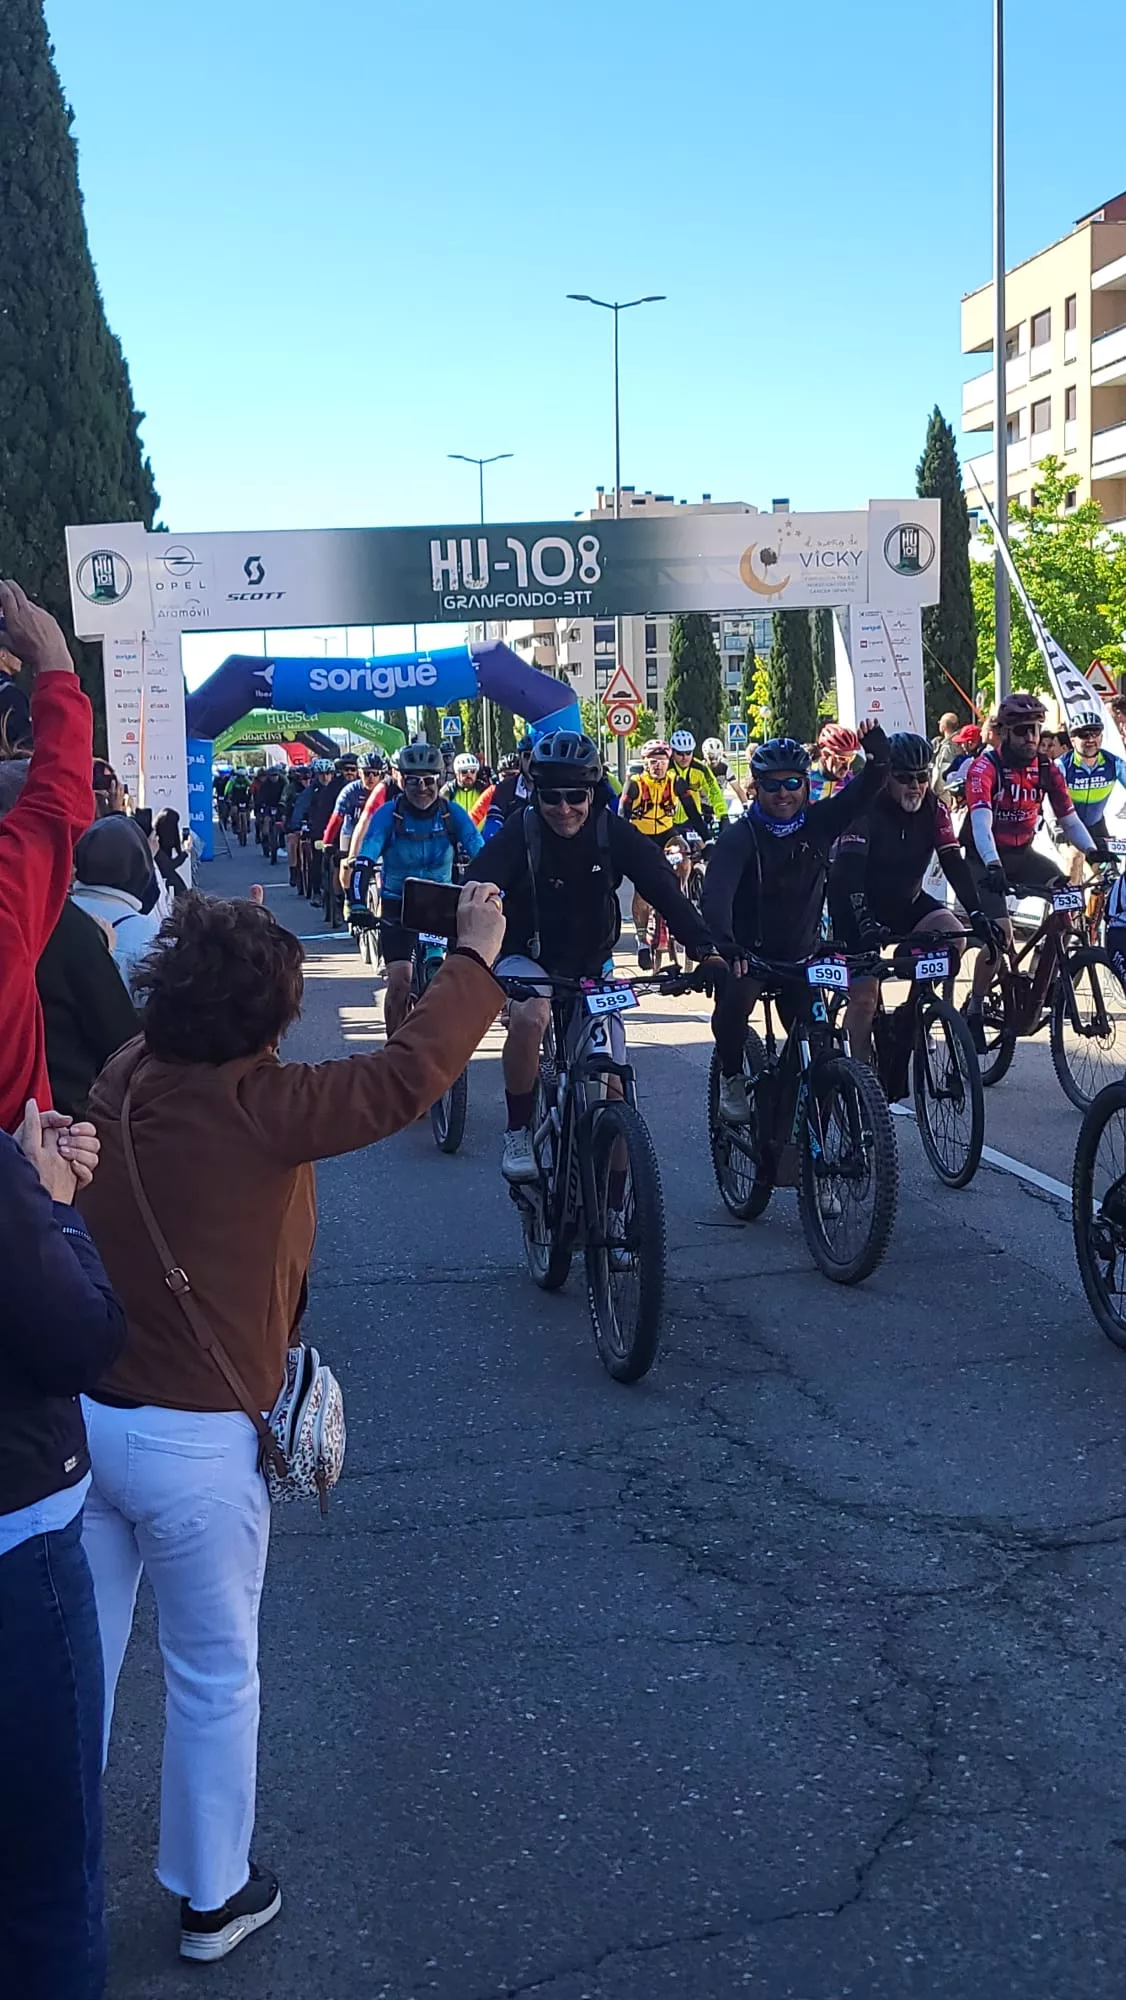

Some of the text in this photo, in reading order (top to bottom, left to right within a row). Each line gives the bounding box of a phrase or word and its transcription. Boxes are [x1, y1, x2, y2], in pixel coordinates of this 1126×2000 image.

[431, 535, 601, 592] HU-108
[155, 581, 206, 591] OPEL
[226, 592, 287, 602] SCOTT
[157, 606, 210, 618] Aramóvil
[614, 714, 631, 725] 20
[1058, 894, 1078, 906] 533
[815, 967, 842, 981] 590
[921, 962, 944, 974] 503
[596, 994, 628, 1008] 589
